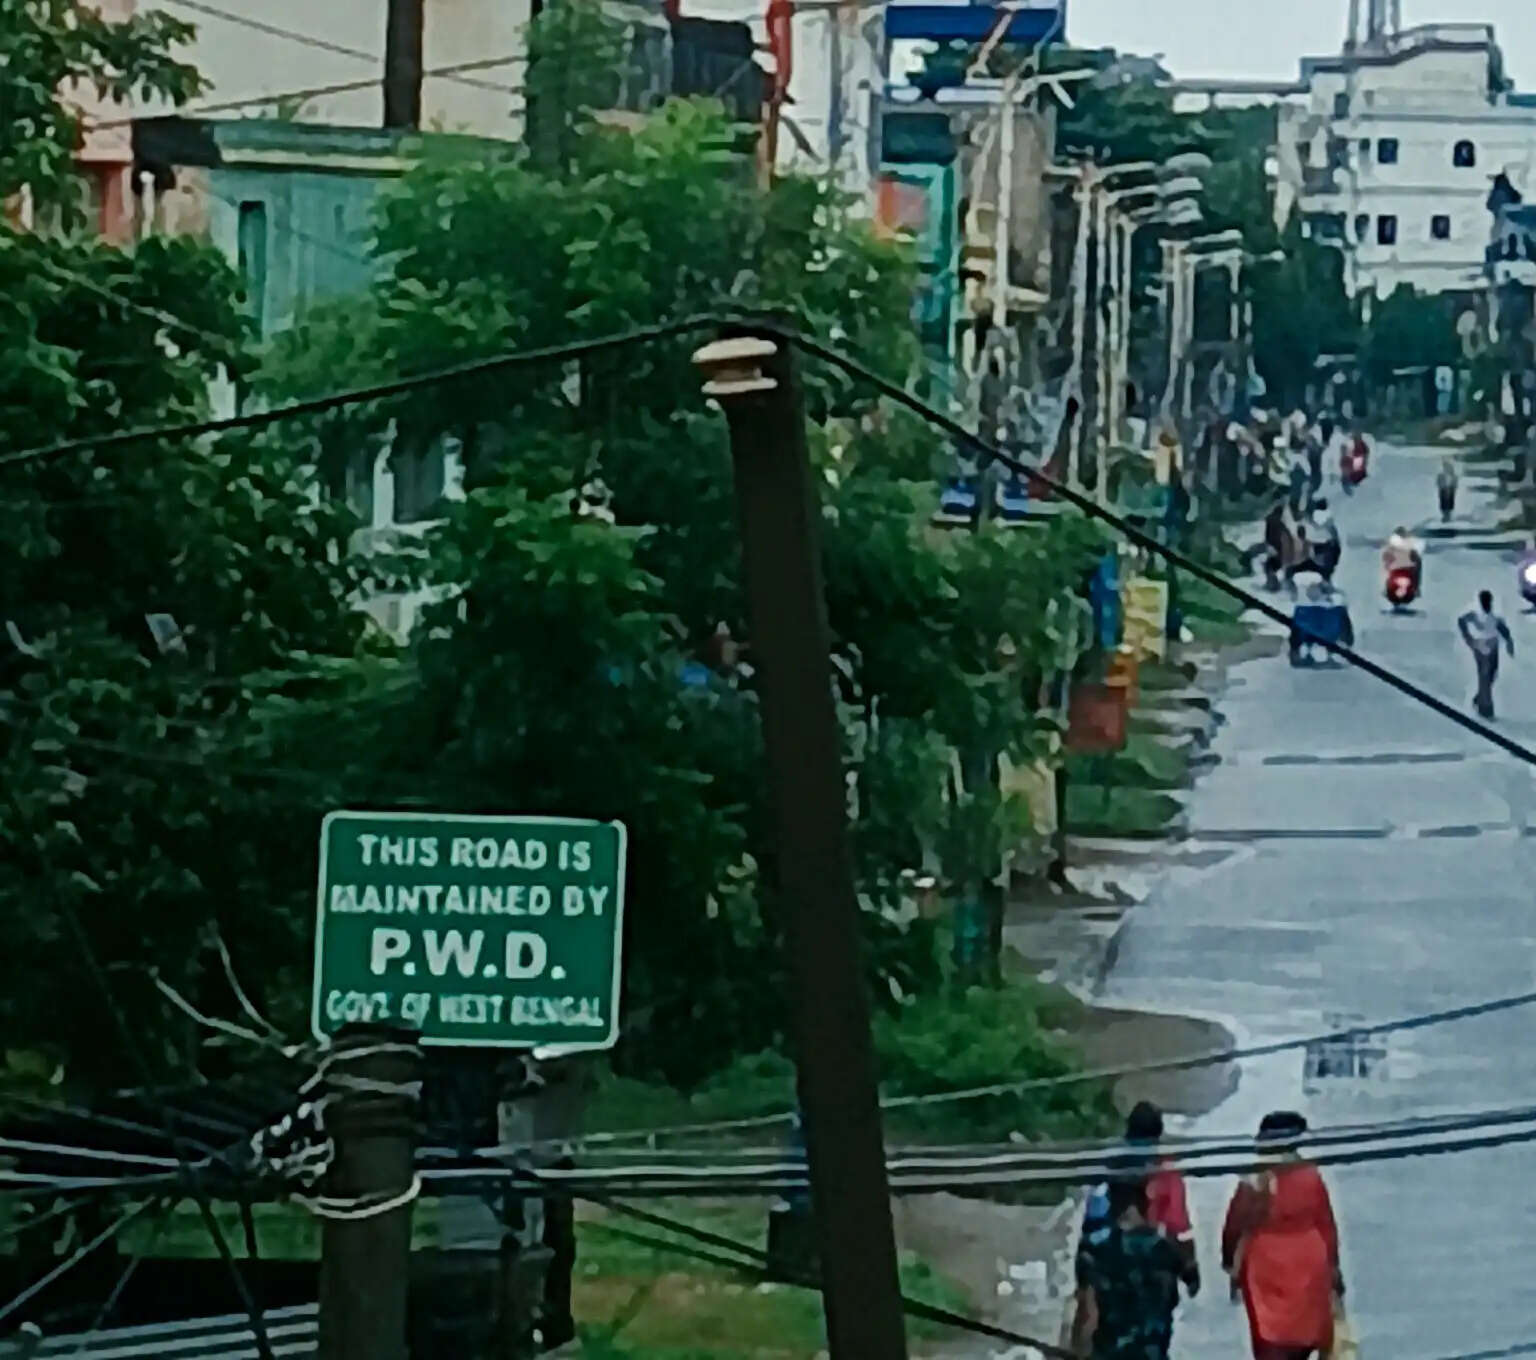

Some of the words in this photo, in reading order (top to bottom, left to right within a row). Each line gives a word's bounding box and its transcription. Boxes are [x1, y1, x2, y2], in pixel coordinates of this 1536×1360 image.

[357, 834, 439, 867] THIS
[451, 836, 548, 870] ROAD
[558, 840, 592, 872] IS
[330, 884, 551, 917] MAINTAINED
[562, 885, 609, 917] BY
[370, 927, 567, 980] P.W.D.
